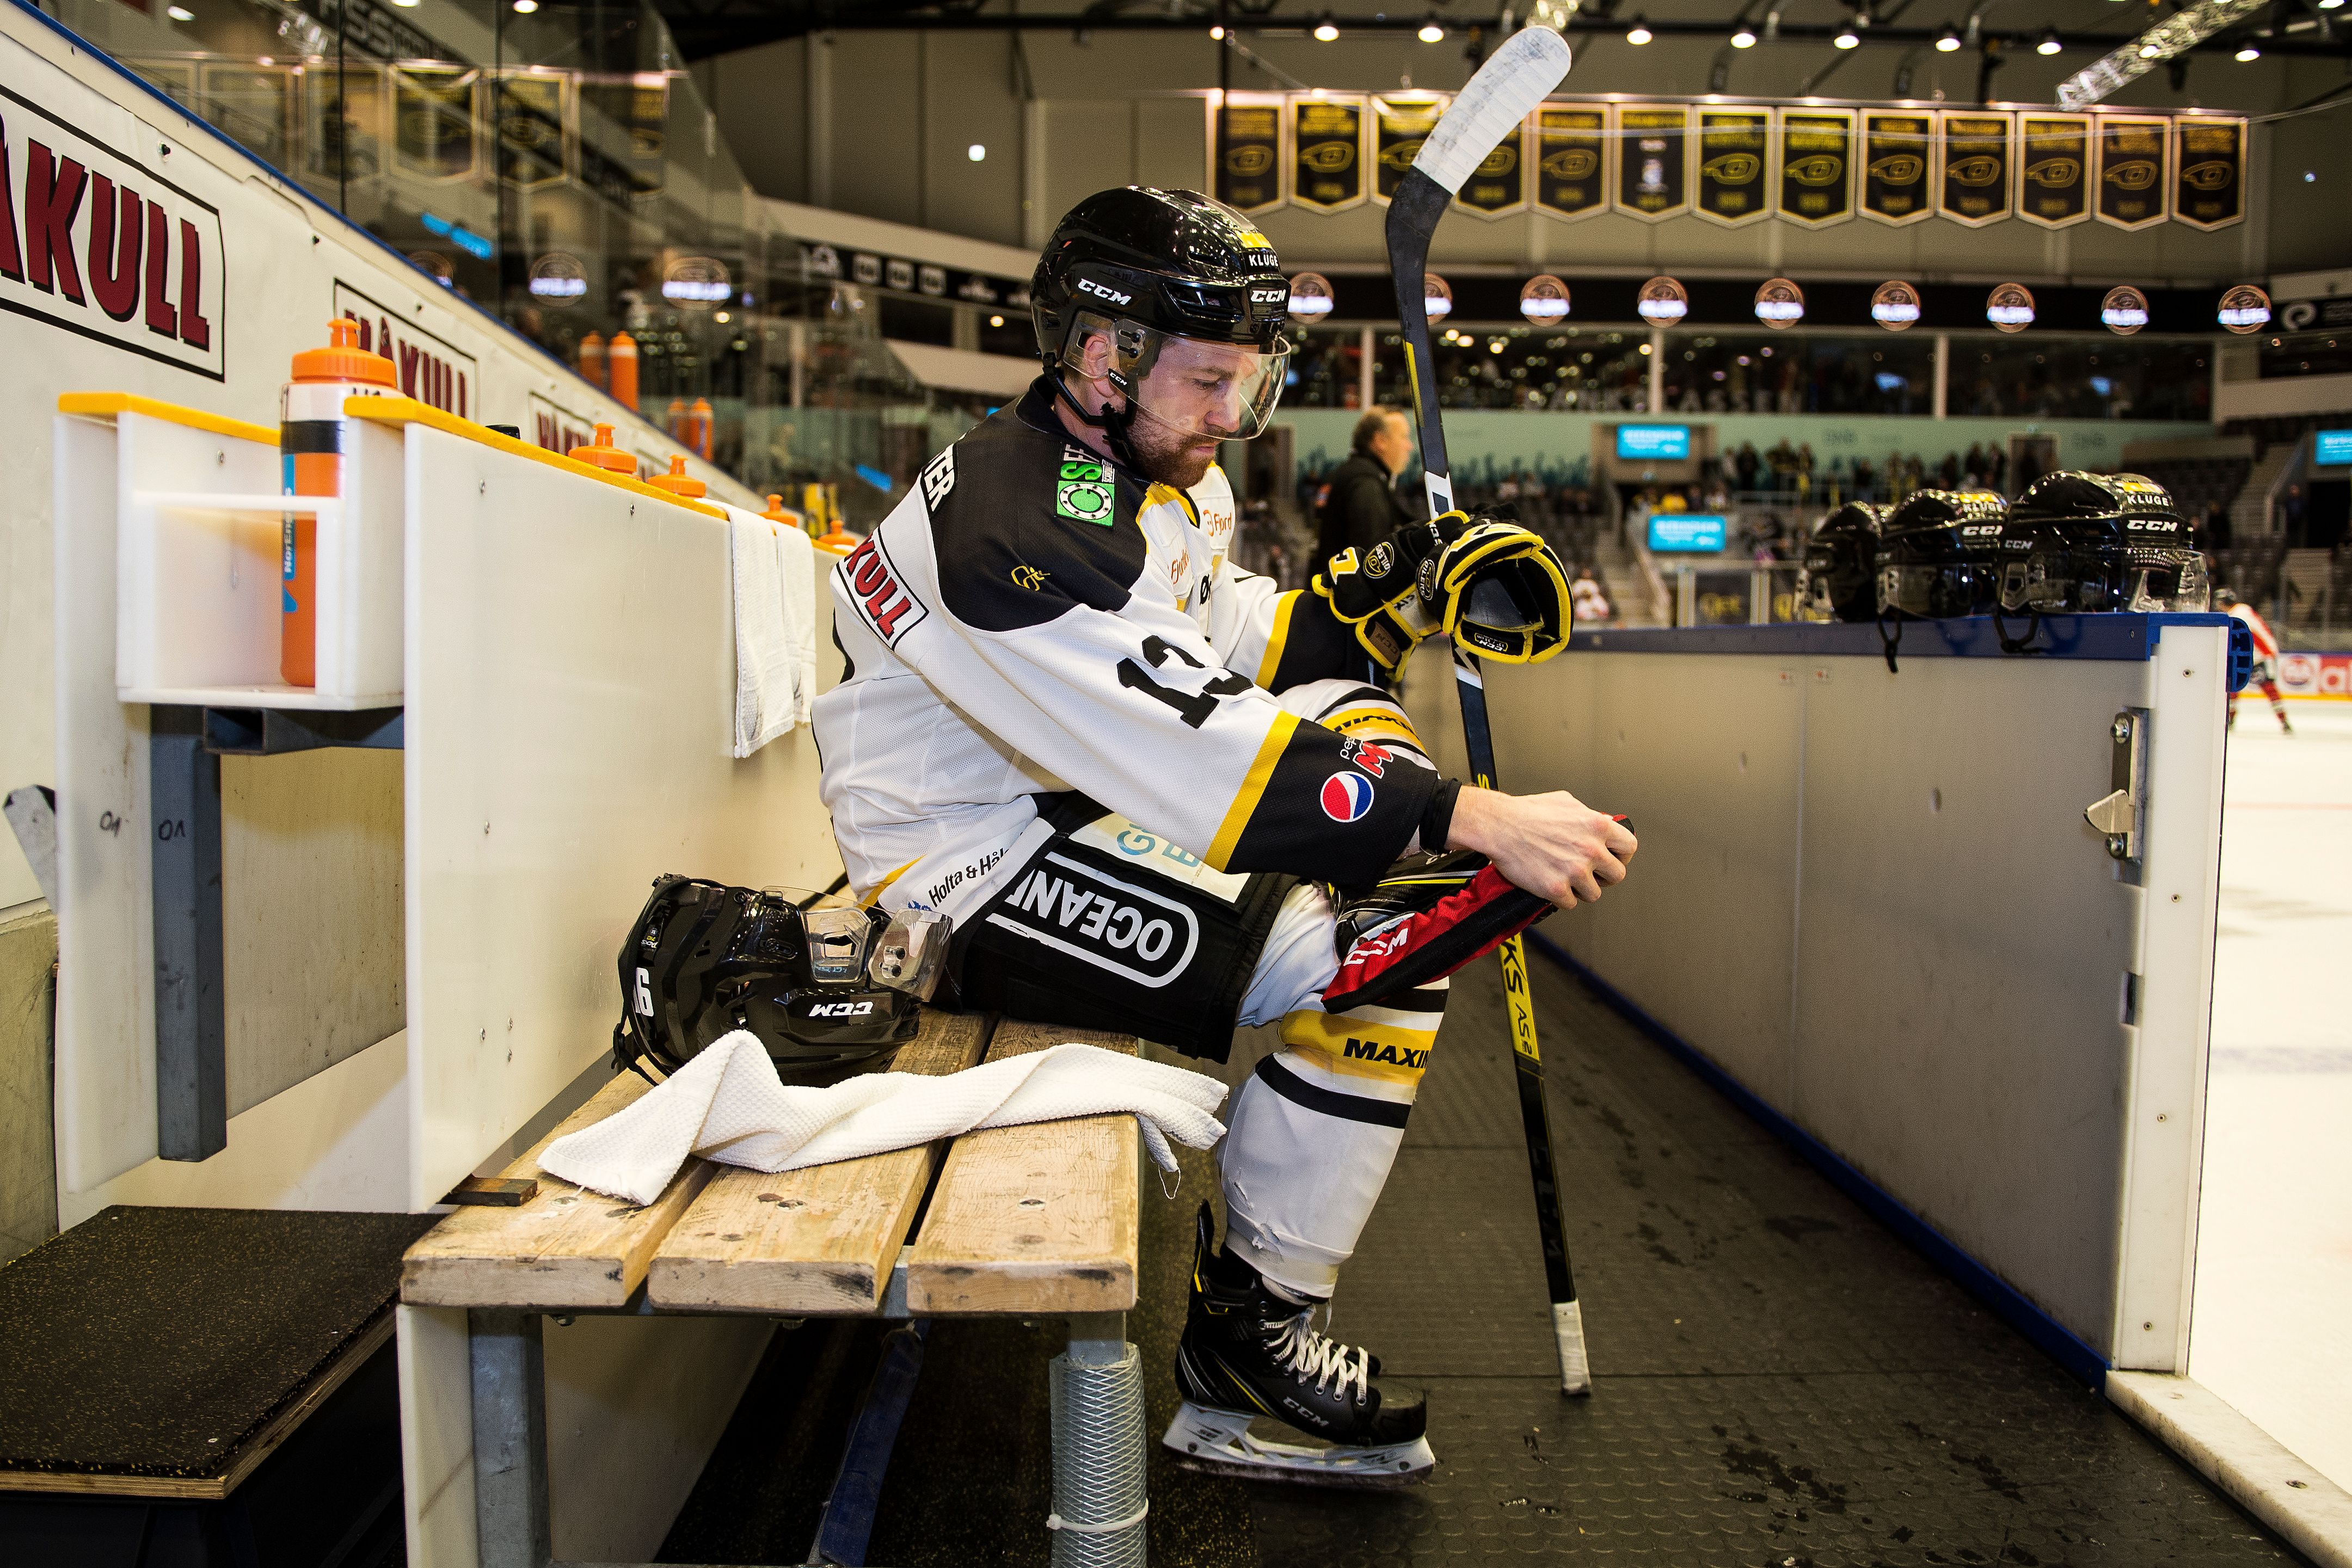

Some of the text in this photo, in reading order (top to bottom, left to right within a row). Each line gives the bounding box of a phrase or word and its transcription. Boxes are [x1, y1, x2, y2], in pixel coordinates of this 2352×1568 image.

[1249, 254, 1279, 268] KLUGE
[1077, 278, 1132, 306] CCM
[1250, 288, 1286, 303] CCM
[1109, 371, 1128, 386] CCM
[924, 442, 955, 513] TER
[2127, 495, 2170, 507] KLUGE
[1213, 512, 1232, 536] Fjord
[2126, 519, 2178, 532] CCM
[2005, 539, 2034, 550] CCM
[1374, 543, 1391, 571] OILERS
[844, 536, 913, 641] KULL
[1479, 640, 1503, 651] CCM
[1340, 736, 1357, 760] pep
[928, 847, 1009, 908] Holta & Hål
[1343, 927, 1409, 967] CCM
[808, 1001, 874, 1017] CCM
[1283, 1395, 1329, 1426] CCM
